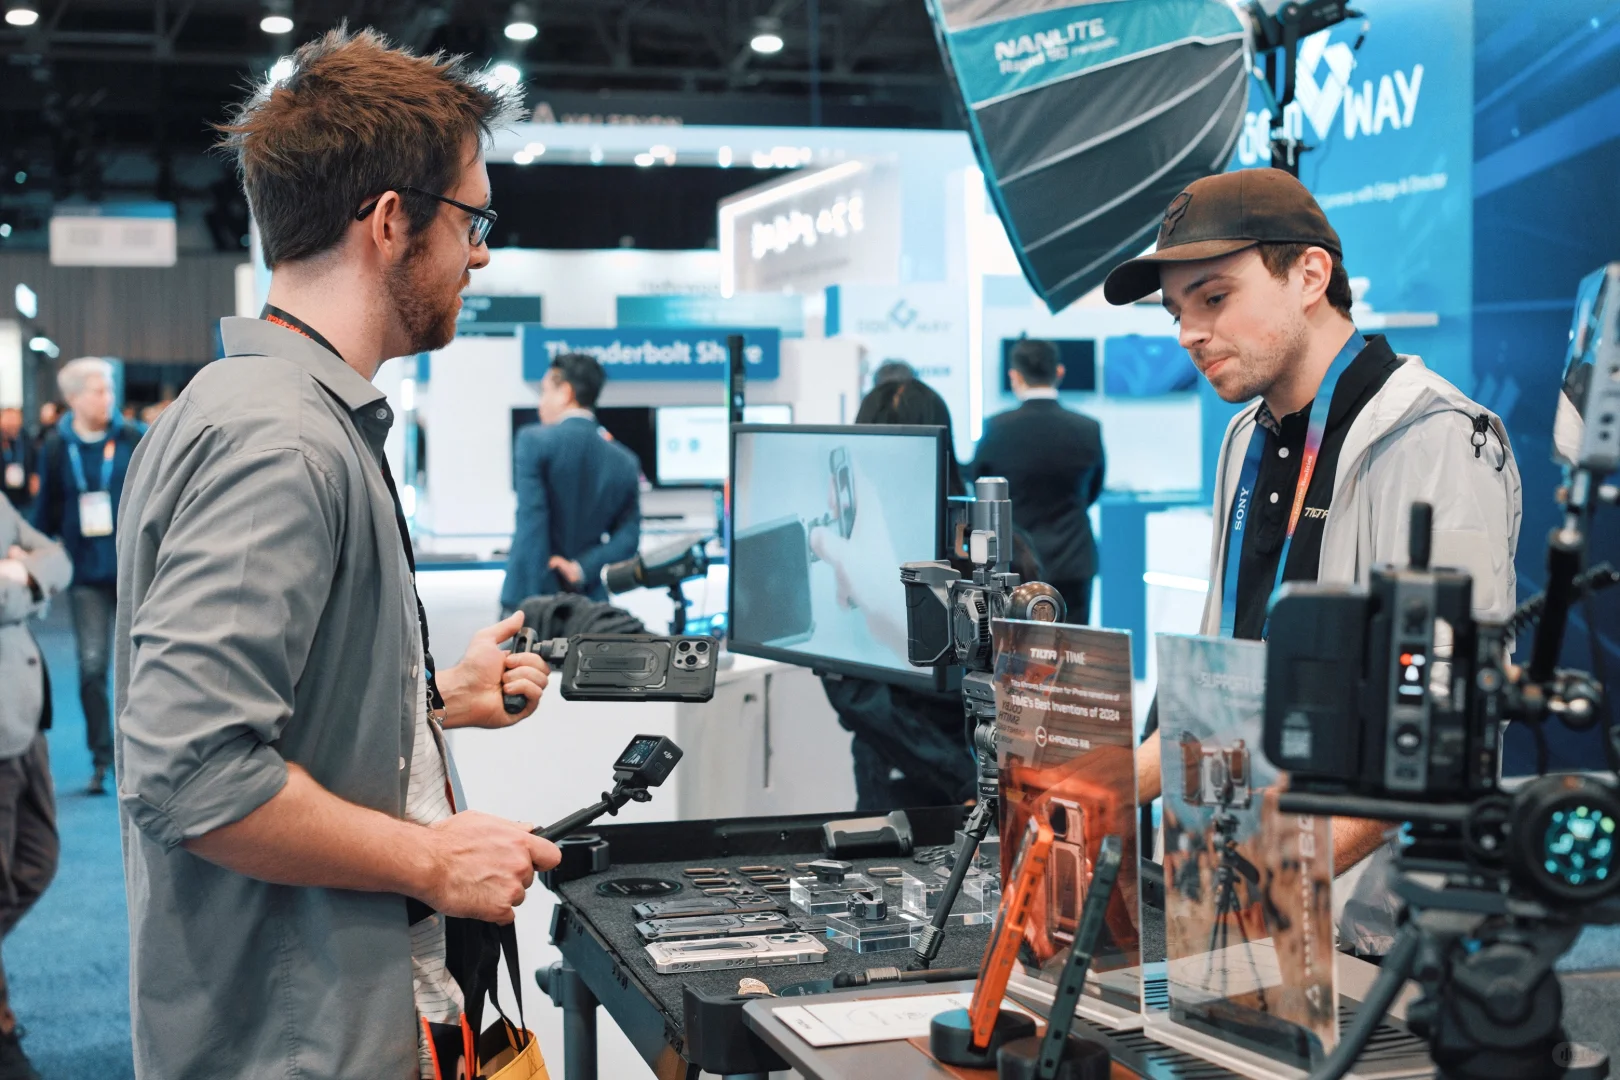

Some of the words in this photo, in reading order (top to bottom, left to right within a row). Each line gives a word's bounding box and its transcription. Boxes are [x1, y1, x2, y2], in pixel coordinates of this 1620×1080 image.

[995, 18, 1105, 61] NANLITE
[1343, 63, 1424, 140] WAY
[696, 341, 763, 365] She
[1235, 487, 1249, 530] SONY
[1030, 648, 1057, 660] TILTA
[1064, 650, 1086, 665] TIME
[1011, 695, 1034, 708] TIME's
[1034, 698, 1051, 711] Best
[1052, 701, 1088, 717] Inventions
[1089, 707, 1098, 718] of
[1099, 708, 1120, 721] 2024
